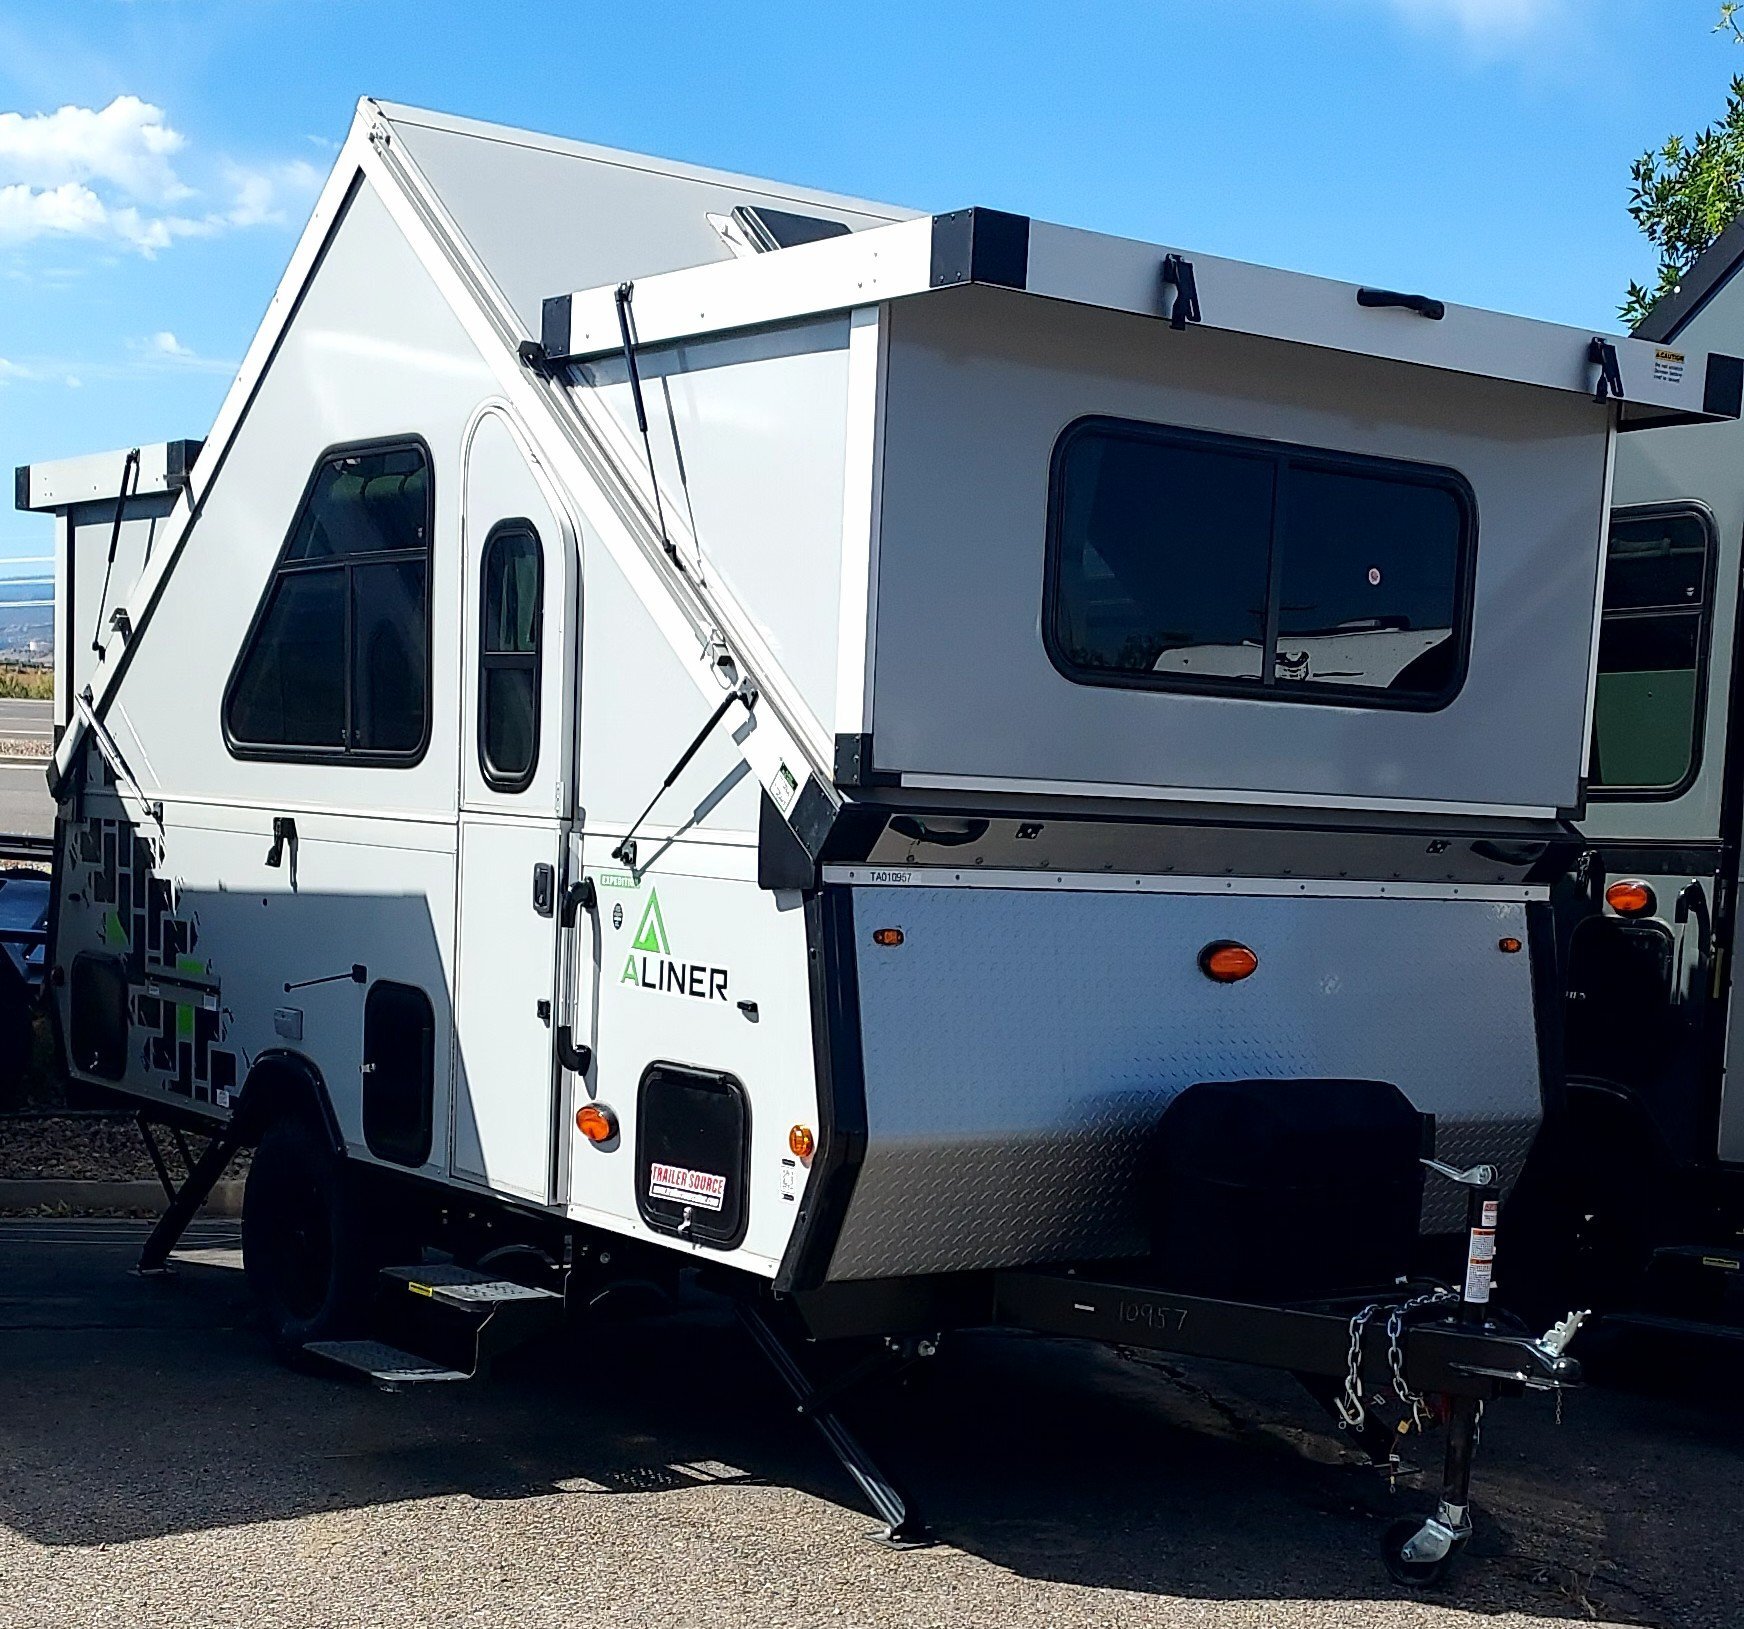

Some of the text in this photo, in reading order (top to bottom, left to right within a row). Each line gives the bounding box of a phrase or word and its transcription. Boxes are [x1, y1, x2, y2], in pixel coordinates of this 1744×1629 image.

[870, 871, 912, 883] TA010957
[620, 955, 728, 1001] ALINER
[652, 1166, 688, 1187] TRAILER
[689, 1173, 723, 1195] SOURCE
[1120, 1301, 1187, 1331] 10957
